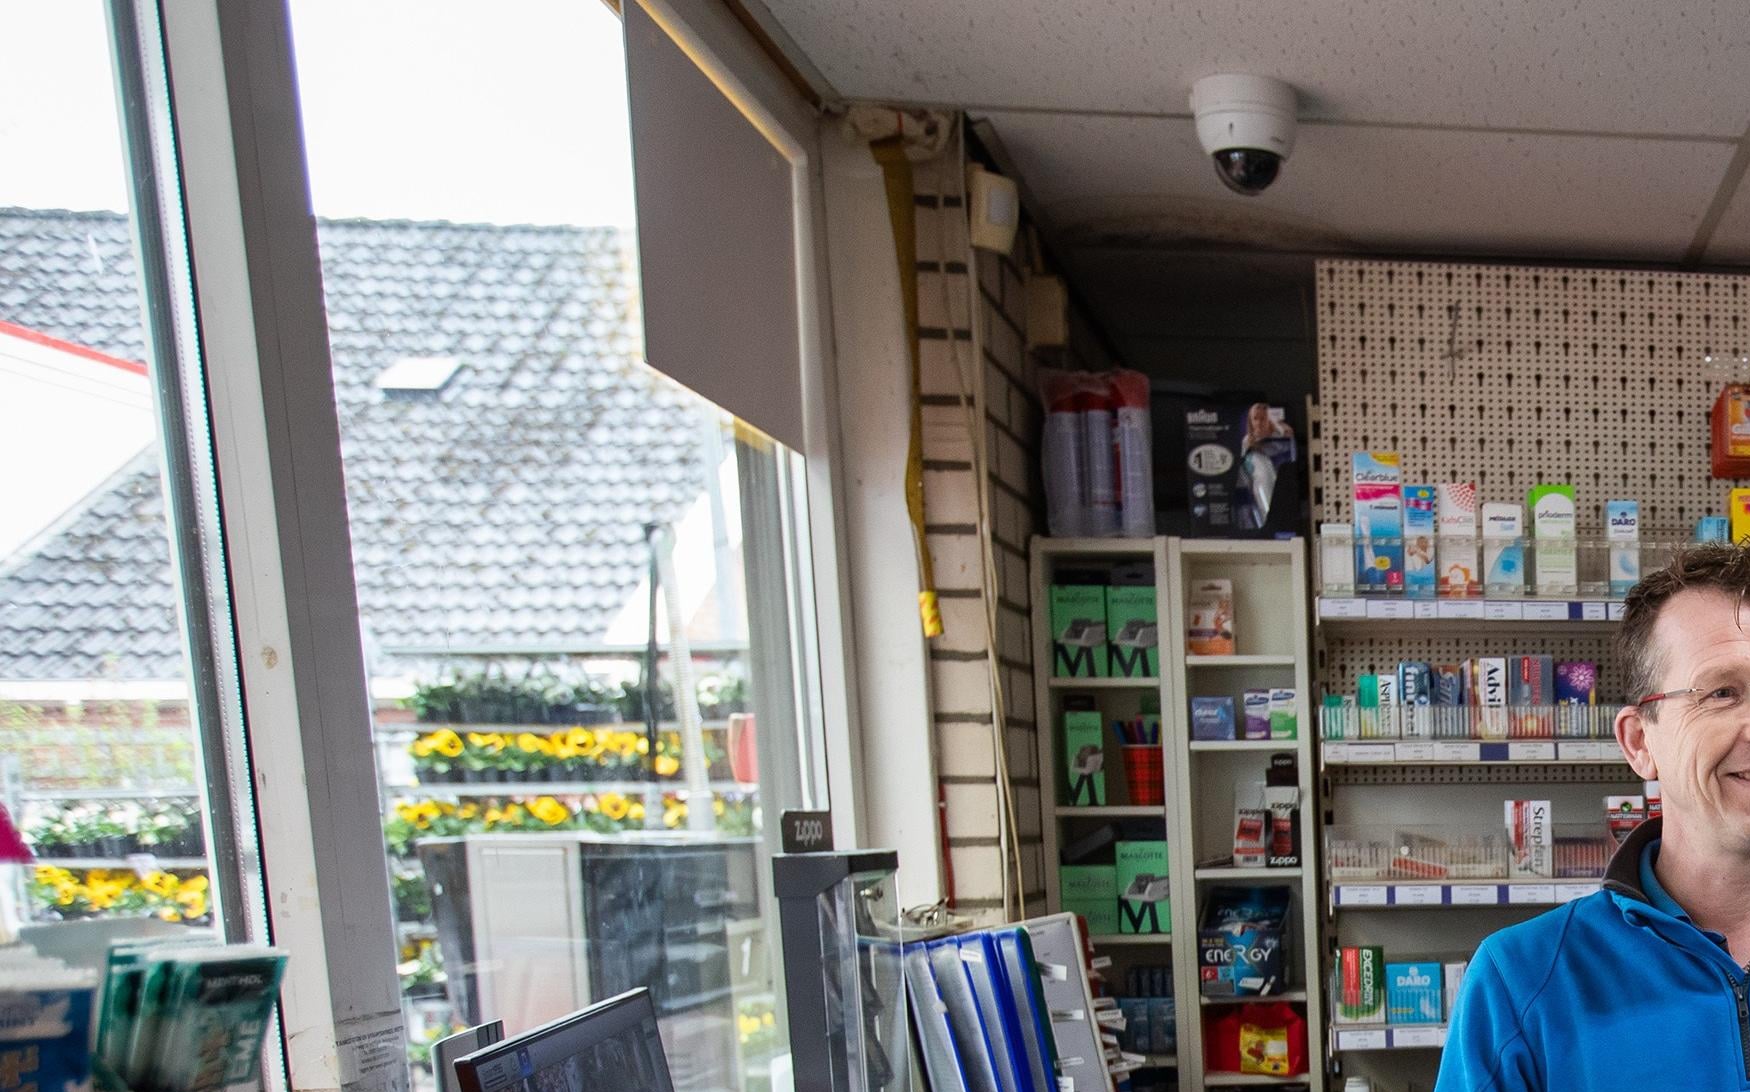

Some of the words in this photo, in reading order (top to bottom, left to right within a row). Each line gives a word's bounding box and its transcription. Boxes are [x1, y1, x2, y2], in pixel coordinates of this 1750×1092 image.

[1355, 471, 1399, 483] Clearblue
[1611, 518, 1635, 526] DARO
[1532, 807, 1545, 867] Strepfen
[1362, 948, 1374, 1006] EXCEDRIN
